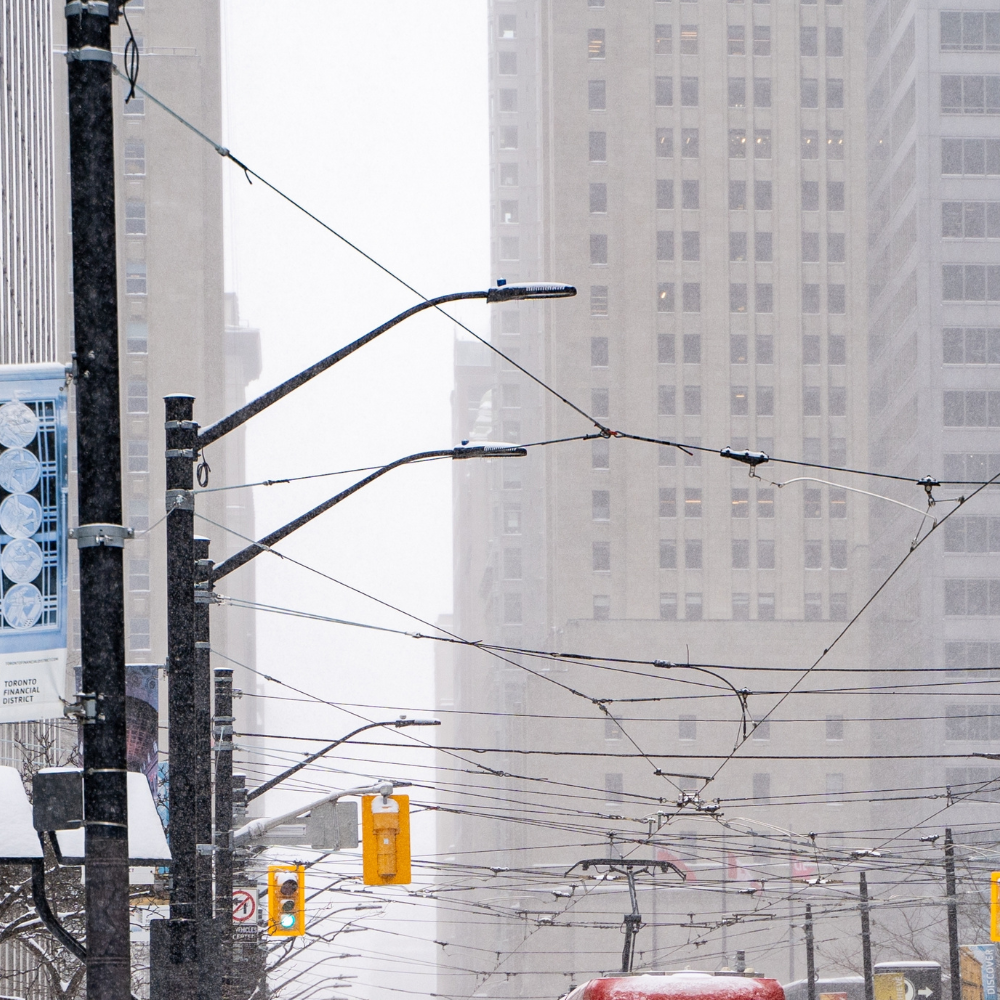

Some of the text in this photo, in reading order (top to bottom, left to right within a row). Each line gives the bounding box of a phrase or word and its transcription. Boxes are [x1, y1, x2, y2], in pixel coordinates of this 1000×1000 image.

[4, 678, 37, 688] TORONTO
[3, 686, 40, 696] FINANCIAL
[2, 695, 34, 705] DISTRICT
[985, 948, 996, 996] DISCOVER
